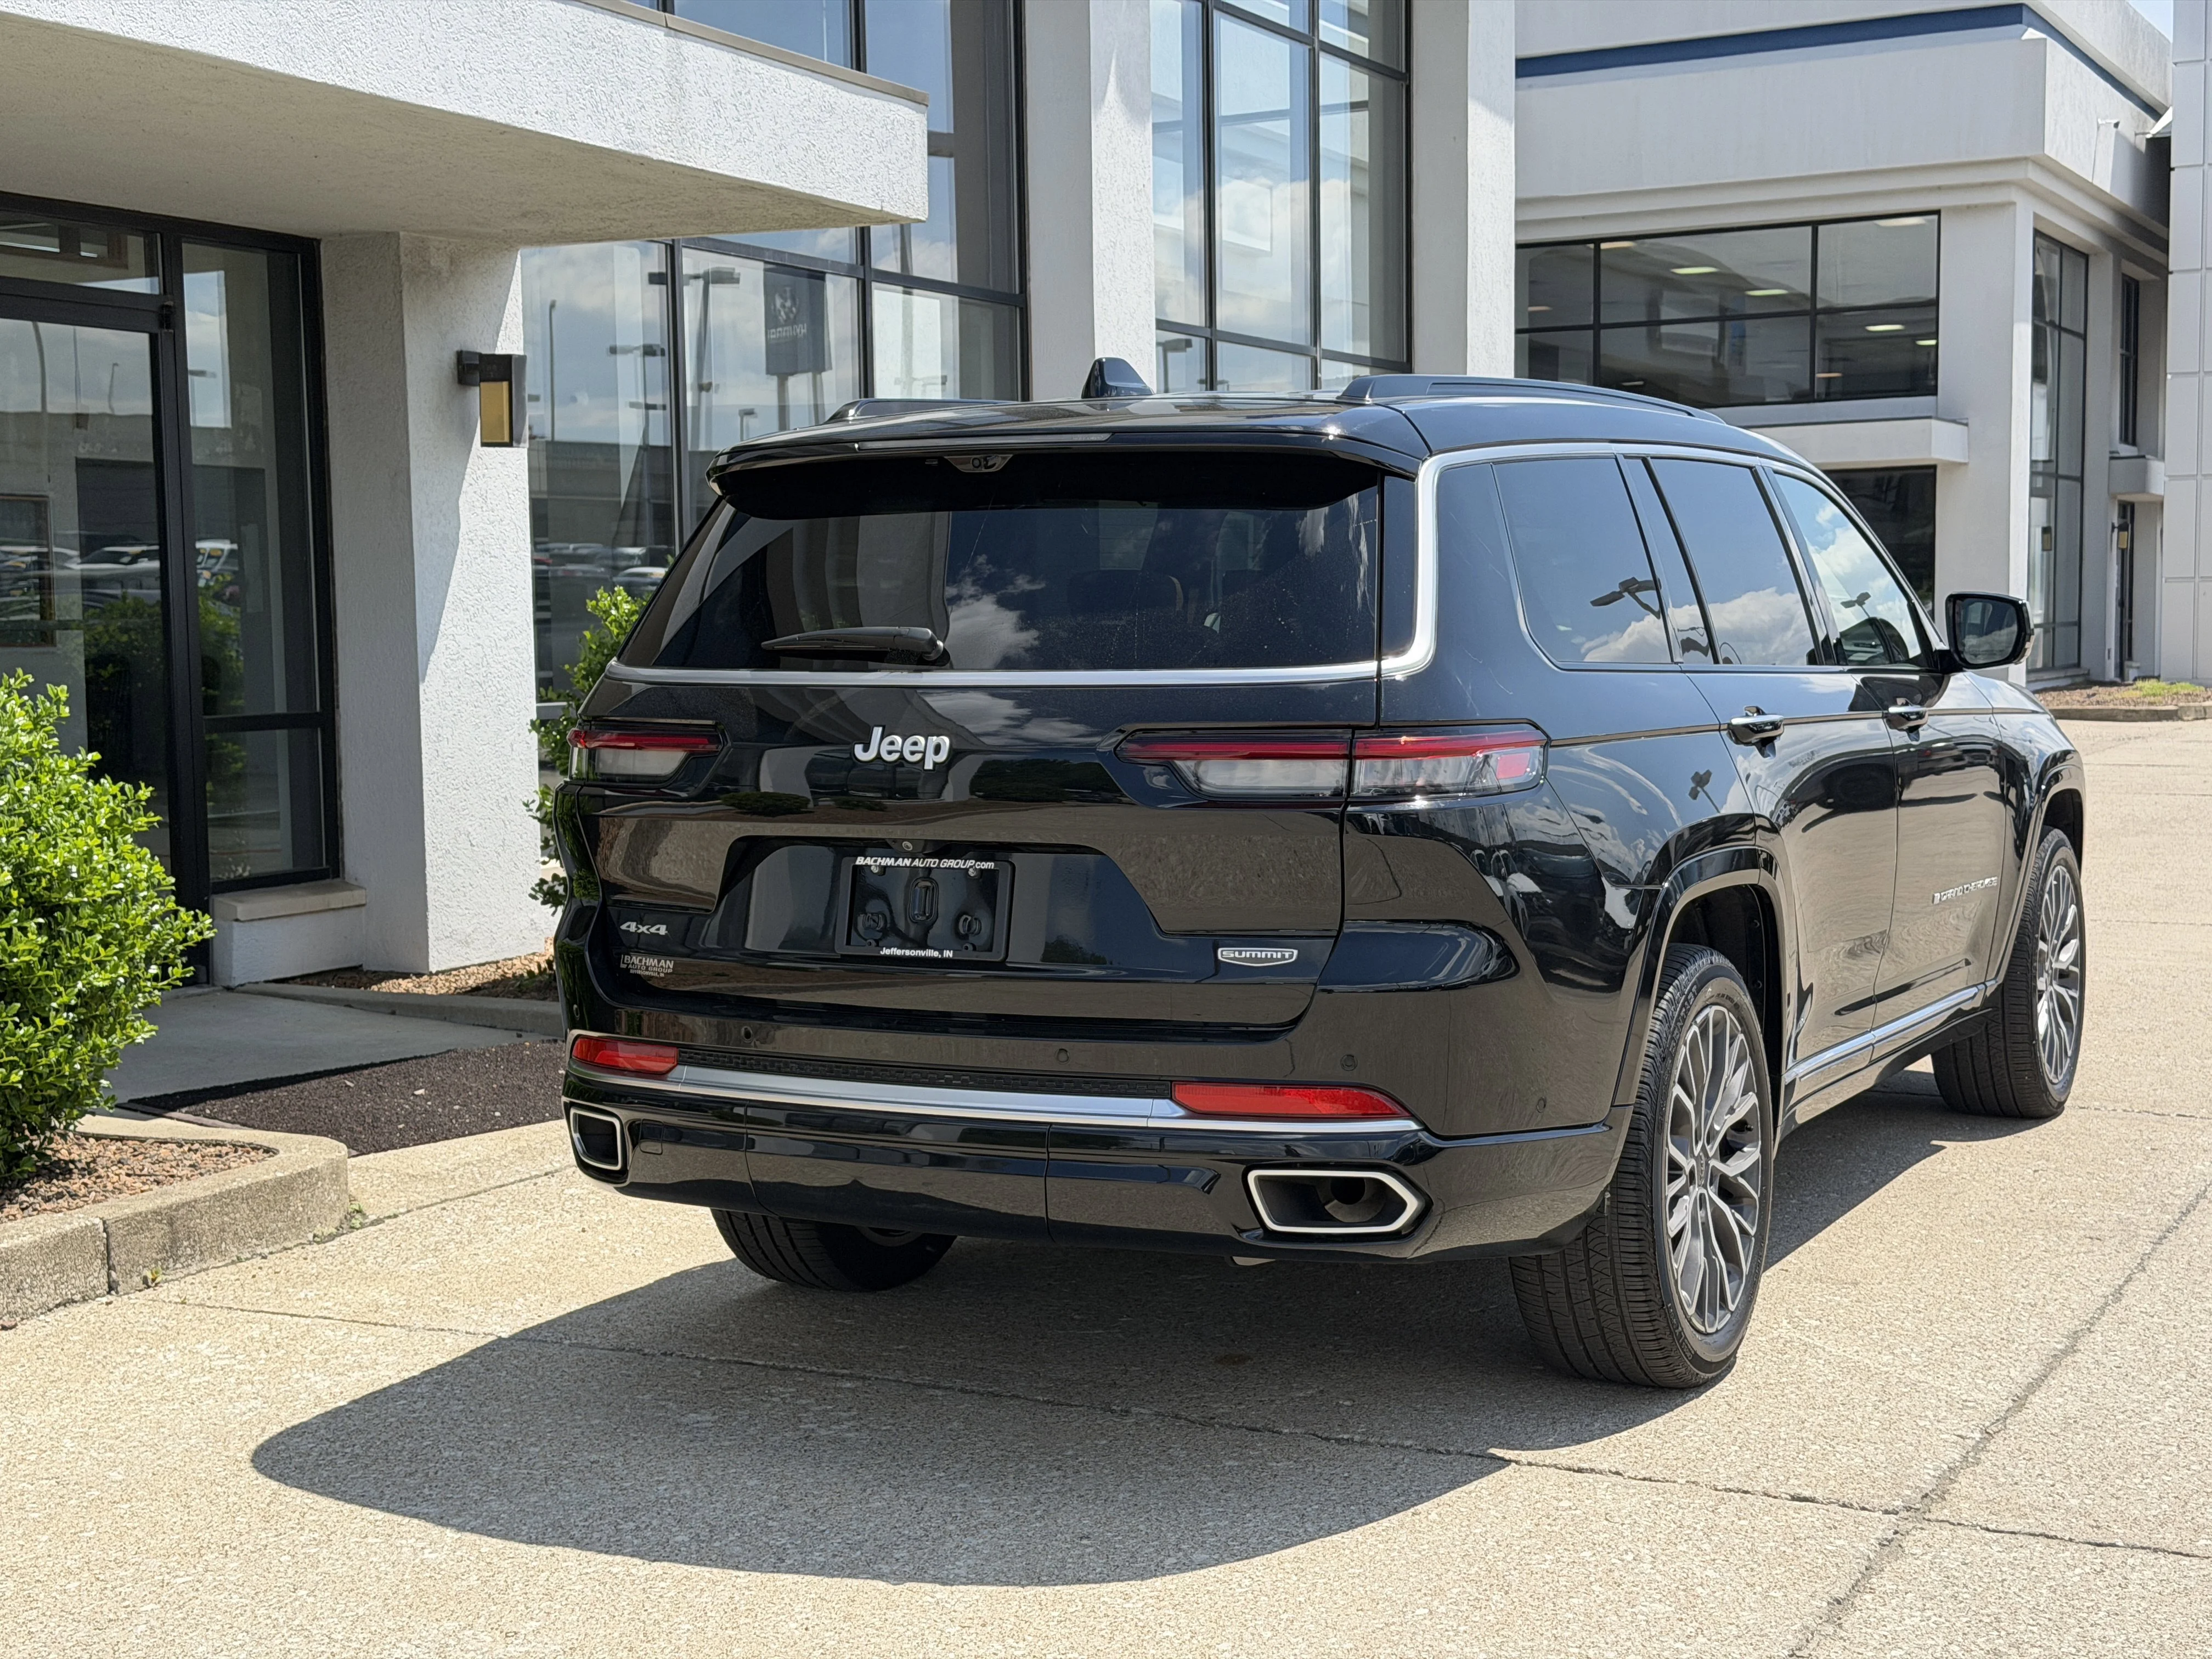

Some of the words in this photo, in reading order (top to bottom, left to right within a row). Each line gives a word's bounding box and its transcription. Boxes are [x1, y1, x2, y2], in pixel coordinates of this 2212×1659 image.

[854, 726, 950, 770] Jeep
[855, 856, 911, 866] BACHMAN
[912, 859, 939, 867] AUTO
[940, 859, 995, 869] GROUP.com
[620, 921, 668, 935] 4x4
[880, 947, 941, 958] Jeffersonville,
[943, 950, 953, 958] IN
[624, 955, 674, 969] BACHMAN
